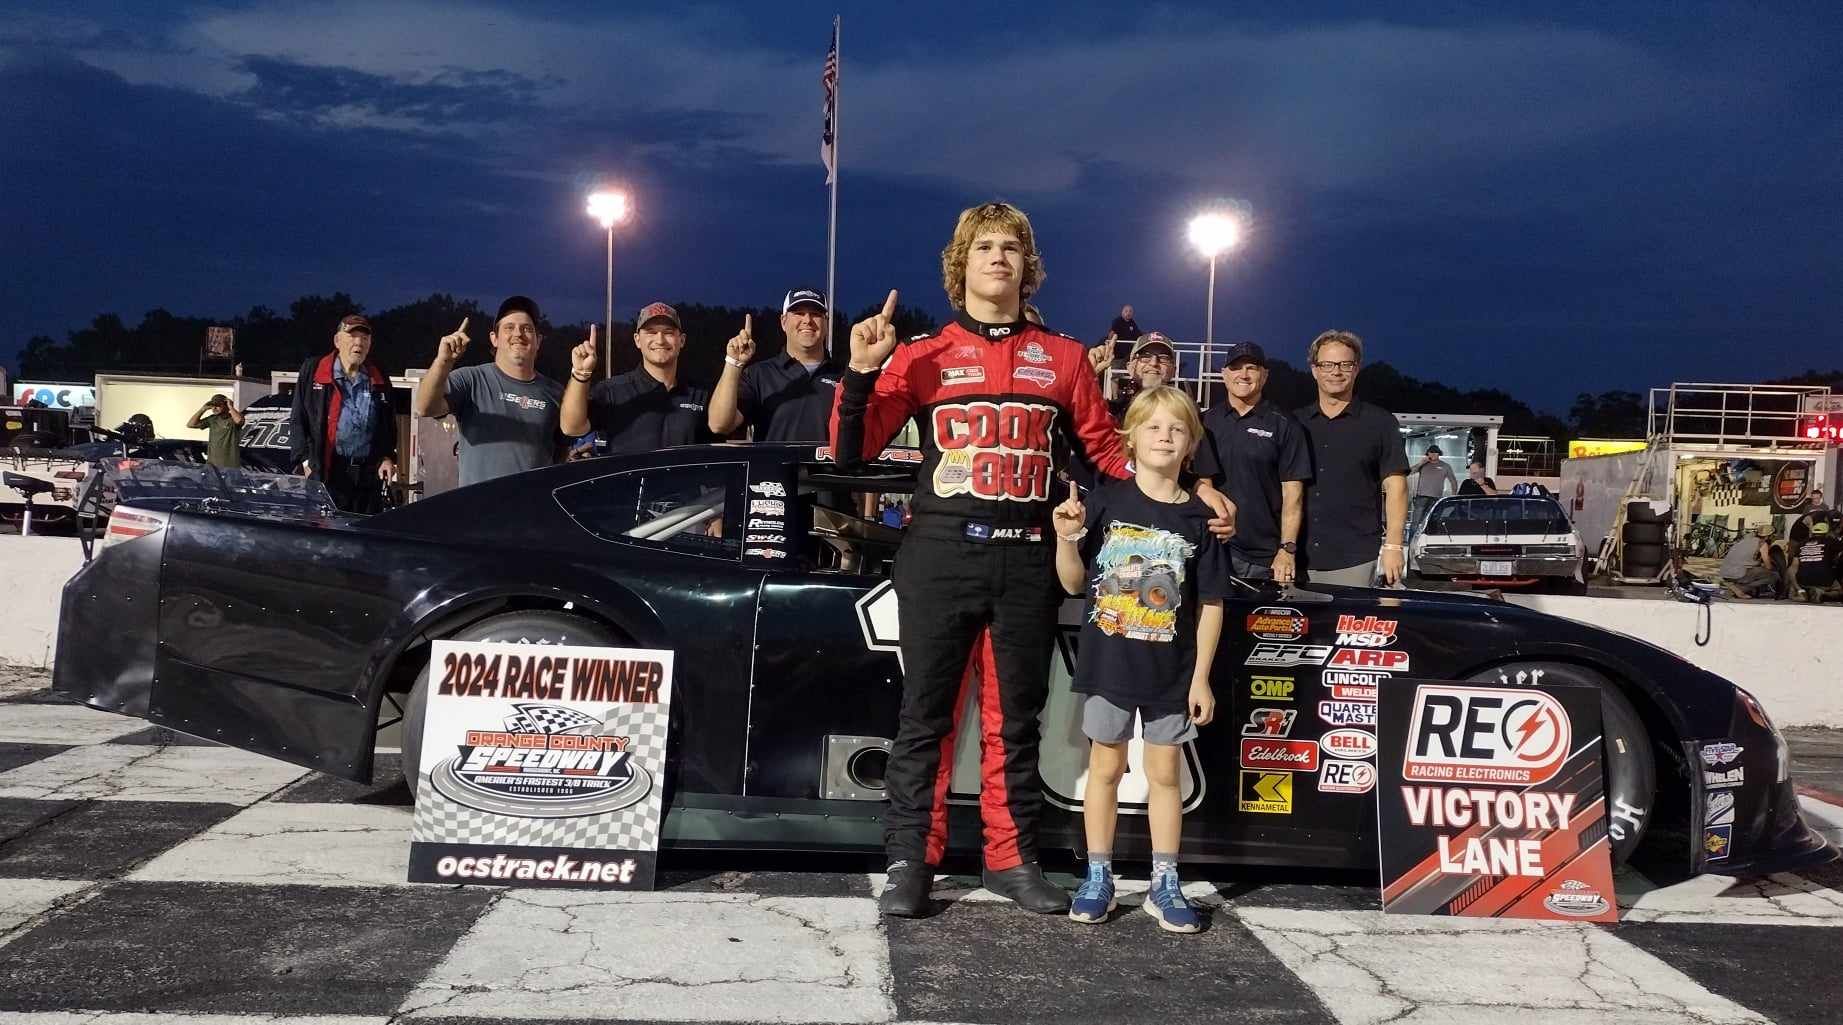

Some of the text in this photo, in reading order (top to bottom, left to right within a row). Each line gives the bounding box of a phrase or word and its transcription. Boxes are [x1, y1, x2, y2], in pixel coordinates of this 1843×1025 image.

[935, 404, 1054, 452] COOK
[972, 452, 1050, 499] OUT
[991, 528, 1024, 539] MAX
[1256, 616, 1292, 625] Advance
[1336, 615, 1398, 636] Holley
[1335, 633, 1388, 647] MSD
[1251, 643, 1331, 659] PFC
[1329, 650, 1408, 668] ARP
[438, 652, 664, 704] 2024 RACE WINNER
[1326, 672, 1383, 686] LINCOL
[1250, 680, 1295, 697] OMP
[1341, 687, 1377, 697] WELDE
[1320, 702, 1377, 716] QUARTE
[1332, 712, 1377, 724] MAST
[467, 731, 629, 752] ORANGE COUNTY
[1330, 735, 1371, 749] BELL
[461, 746, 625, 776] SPEEDWAY
[1248, 746, 1310, 764] Edelbrock
[1410, 765, 1530, 781] RACING ELECTRONICS
[474, 775, 522, 785] AMERICA'S
[522, 776, 564, 787] FASTEST
[581, 778, 612, 788] TRACK
[1241, 803, 1289, 812] KENNAMETAL
[1401, 785, 1577, 830] VICTORY
[1438, 835, 1546, 877] LANE
[436, 853, 637, 884] ocstrack.net
[1551, 893, 1600, 904] SPEEDWAY
